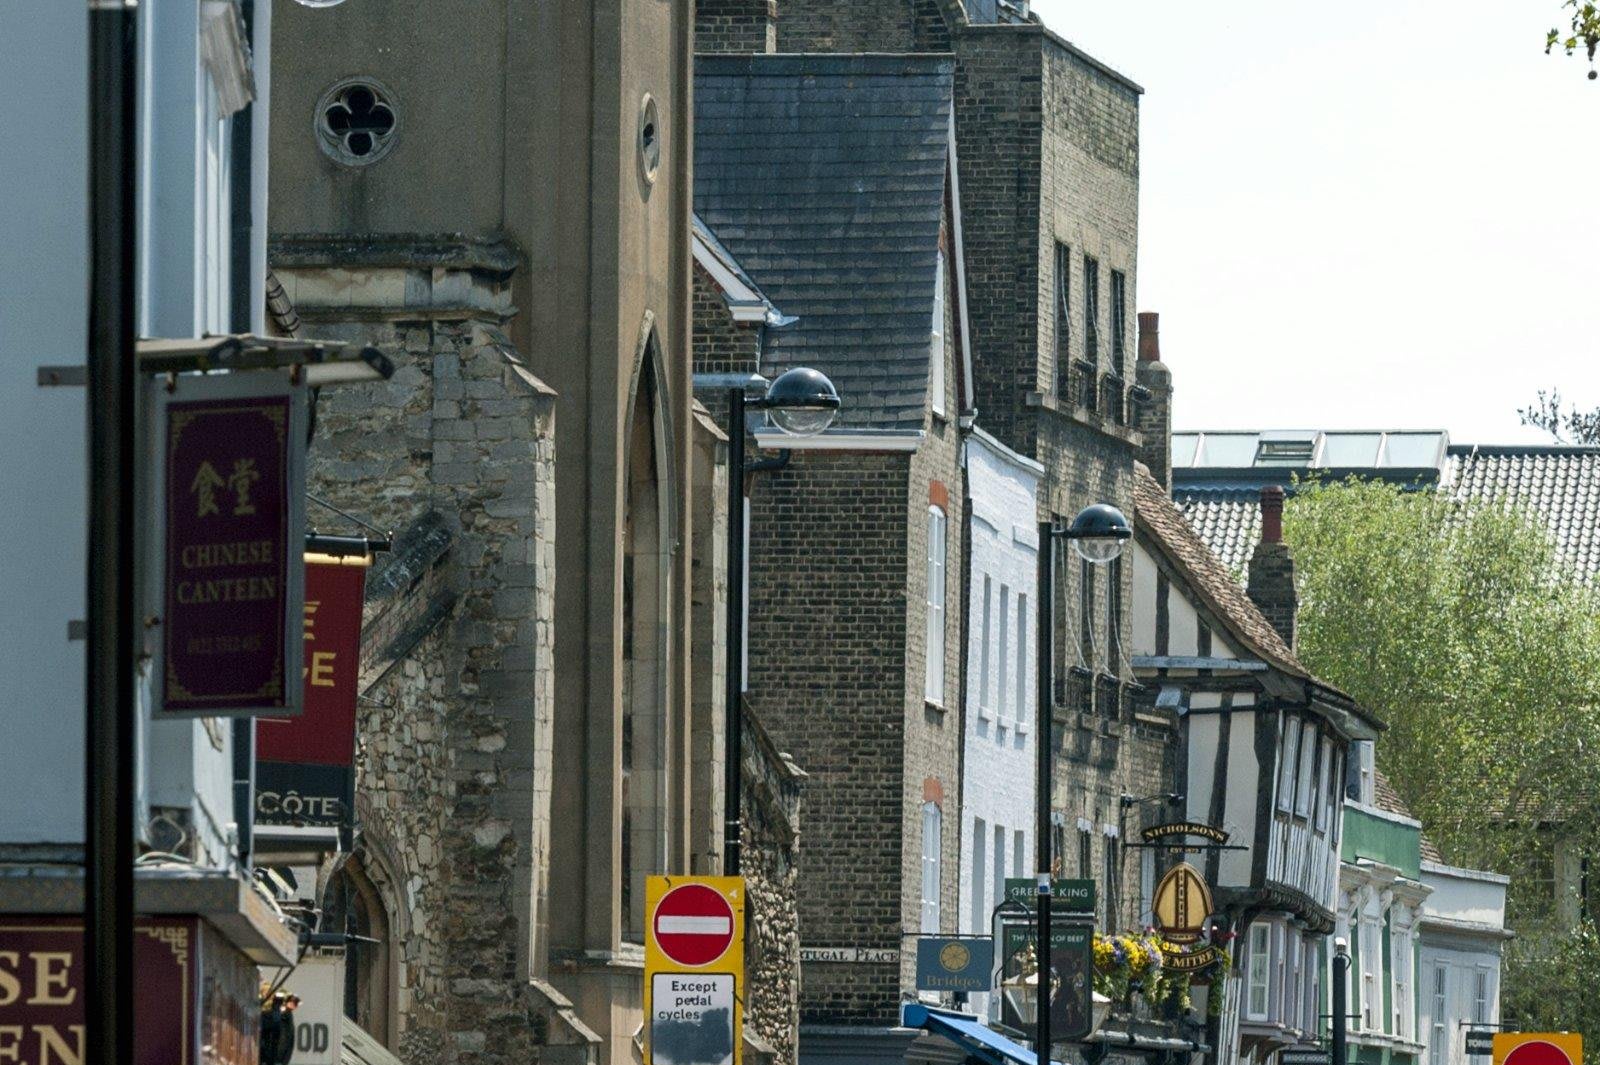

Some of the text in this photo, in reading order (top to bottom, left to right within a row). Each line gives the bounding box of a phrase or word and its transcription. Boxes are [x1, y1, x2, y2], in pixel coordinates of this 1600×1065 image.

[181, 541, 273, 569] CHINESE
[176, 576, 277, 604] CANTEEN
[257, 789, 339, 816] CÔTE
[1145, 823, 1226, 842] NICHOLSON'S
[1012, 887, 1088, 897] GREEE KING
[855, 947, 900, 962] PLACE
[1173, 951, 1214, 968] MITRE
[671, 980, 718, 994] Except
[926, 975, 982, 988] Bridges
[675, 995, 712, 1008] pedal
[658, 1009, 700, 1021] cycles
